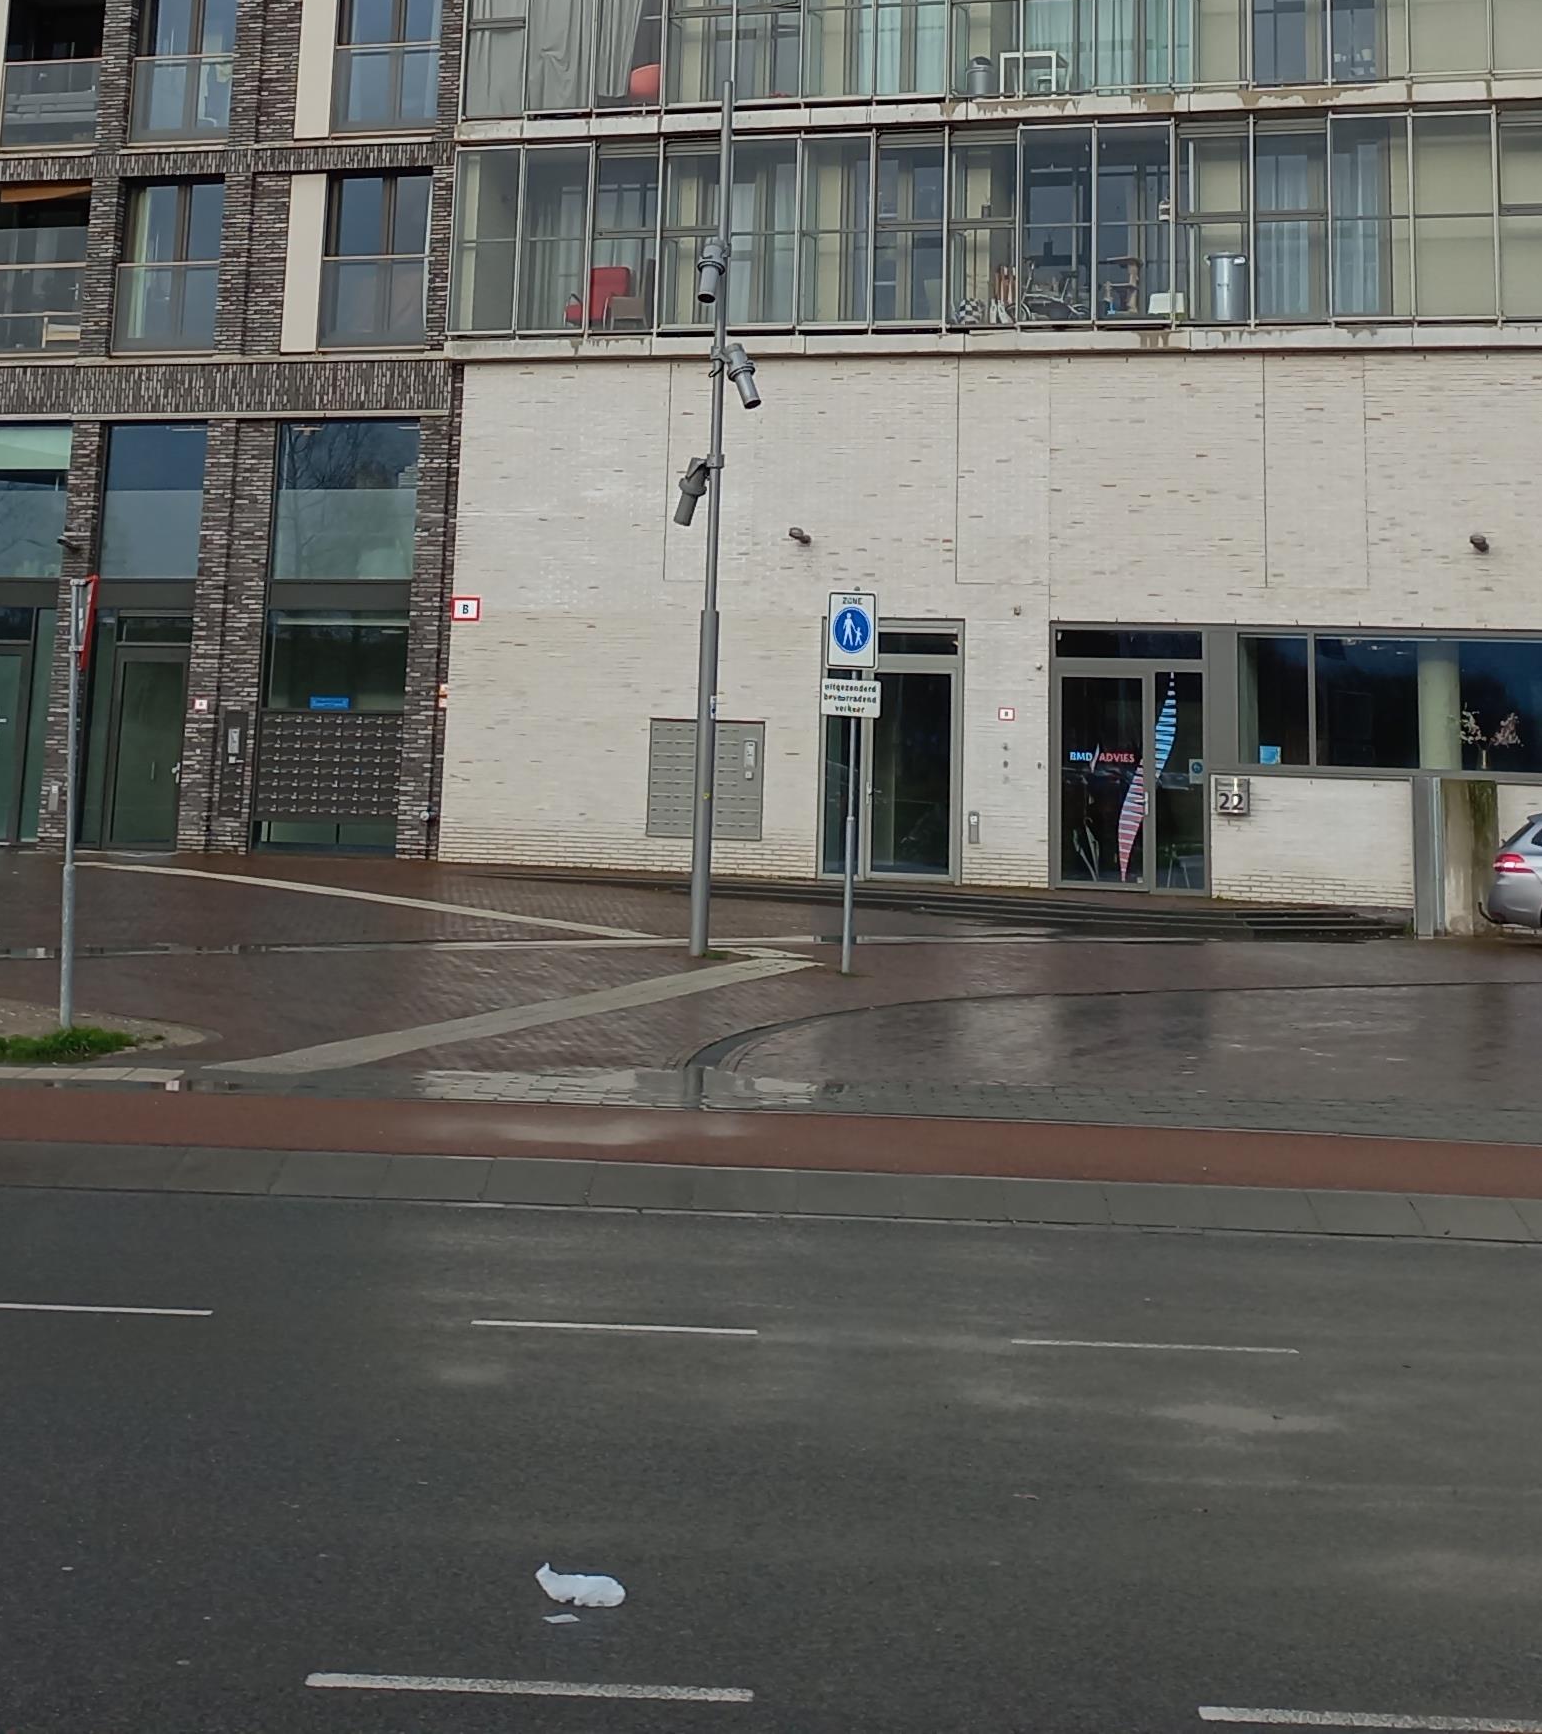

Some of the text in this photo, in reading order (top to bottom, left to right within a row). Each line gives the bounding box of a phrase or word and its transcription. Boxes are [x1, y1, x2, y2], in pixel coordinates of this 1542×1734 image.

[842, 596, 864, 606] ZONE
[462, 604, 470, 615] B
[824, 683, 877, 693] uitgezonderd
[1069, 751, 1135, 763] BMD ADVIES
[1219, 792, 1244, 811] 22
